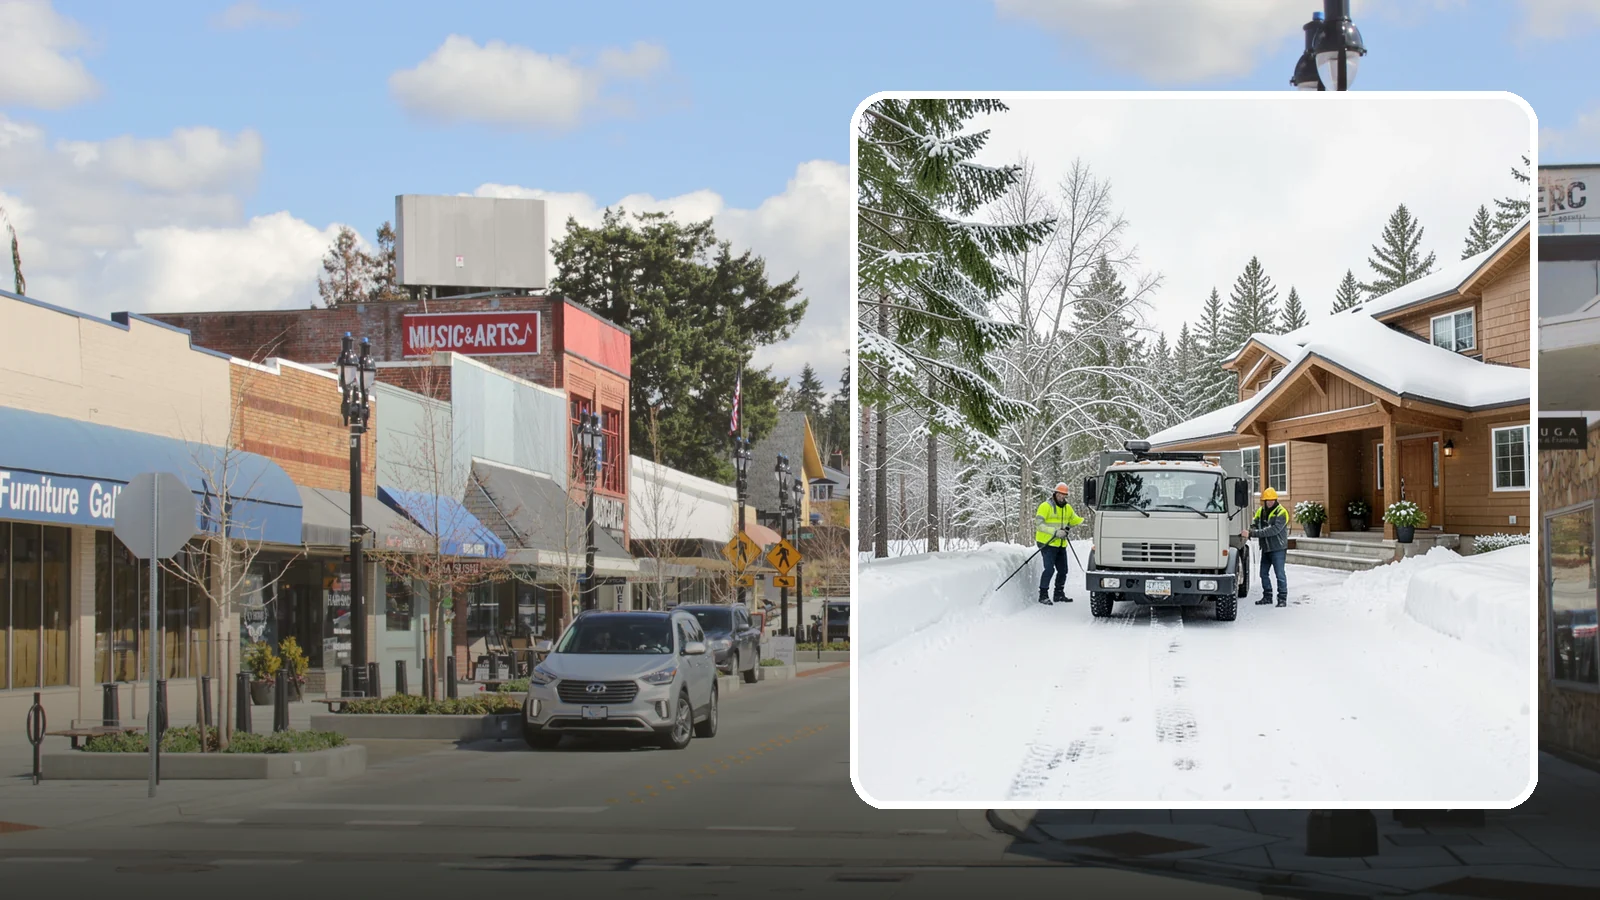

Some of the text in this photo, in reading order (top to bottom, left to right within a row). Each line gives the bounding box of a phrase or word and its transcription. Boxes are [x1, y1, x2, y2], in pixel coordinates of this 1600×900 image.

[408, 323, 520, 349] MUSIC&ARTS
[0, 471, 122, 519] Furniture Gal
[453, 563, 480, 574] SUSHI
